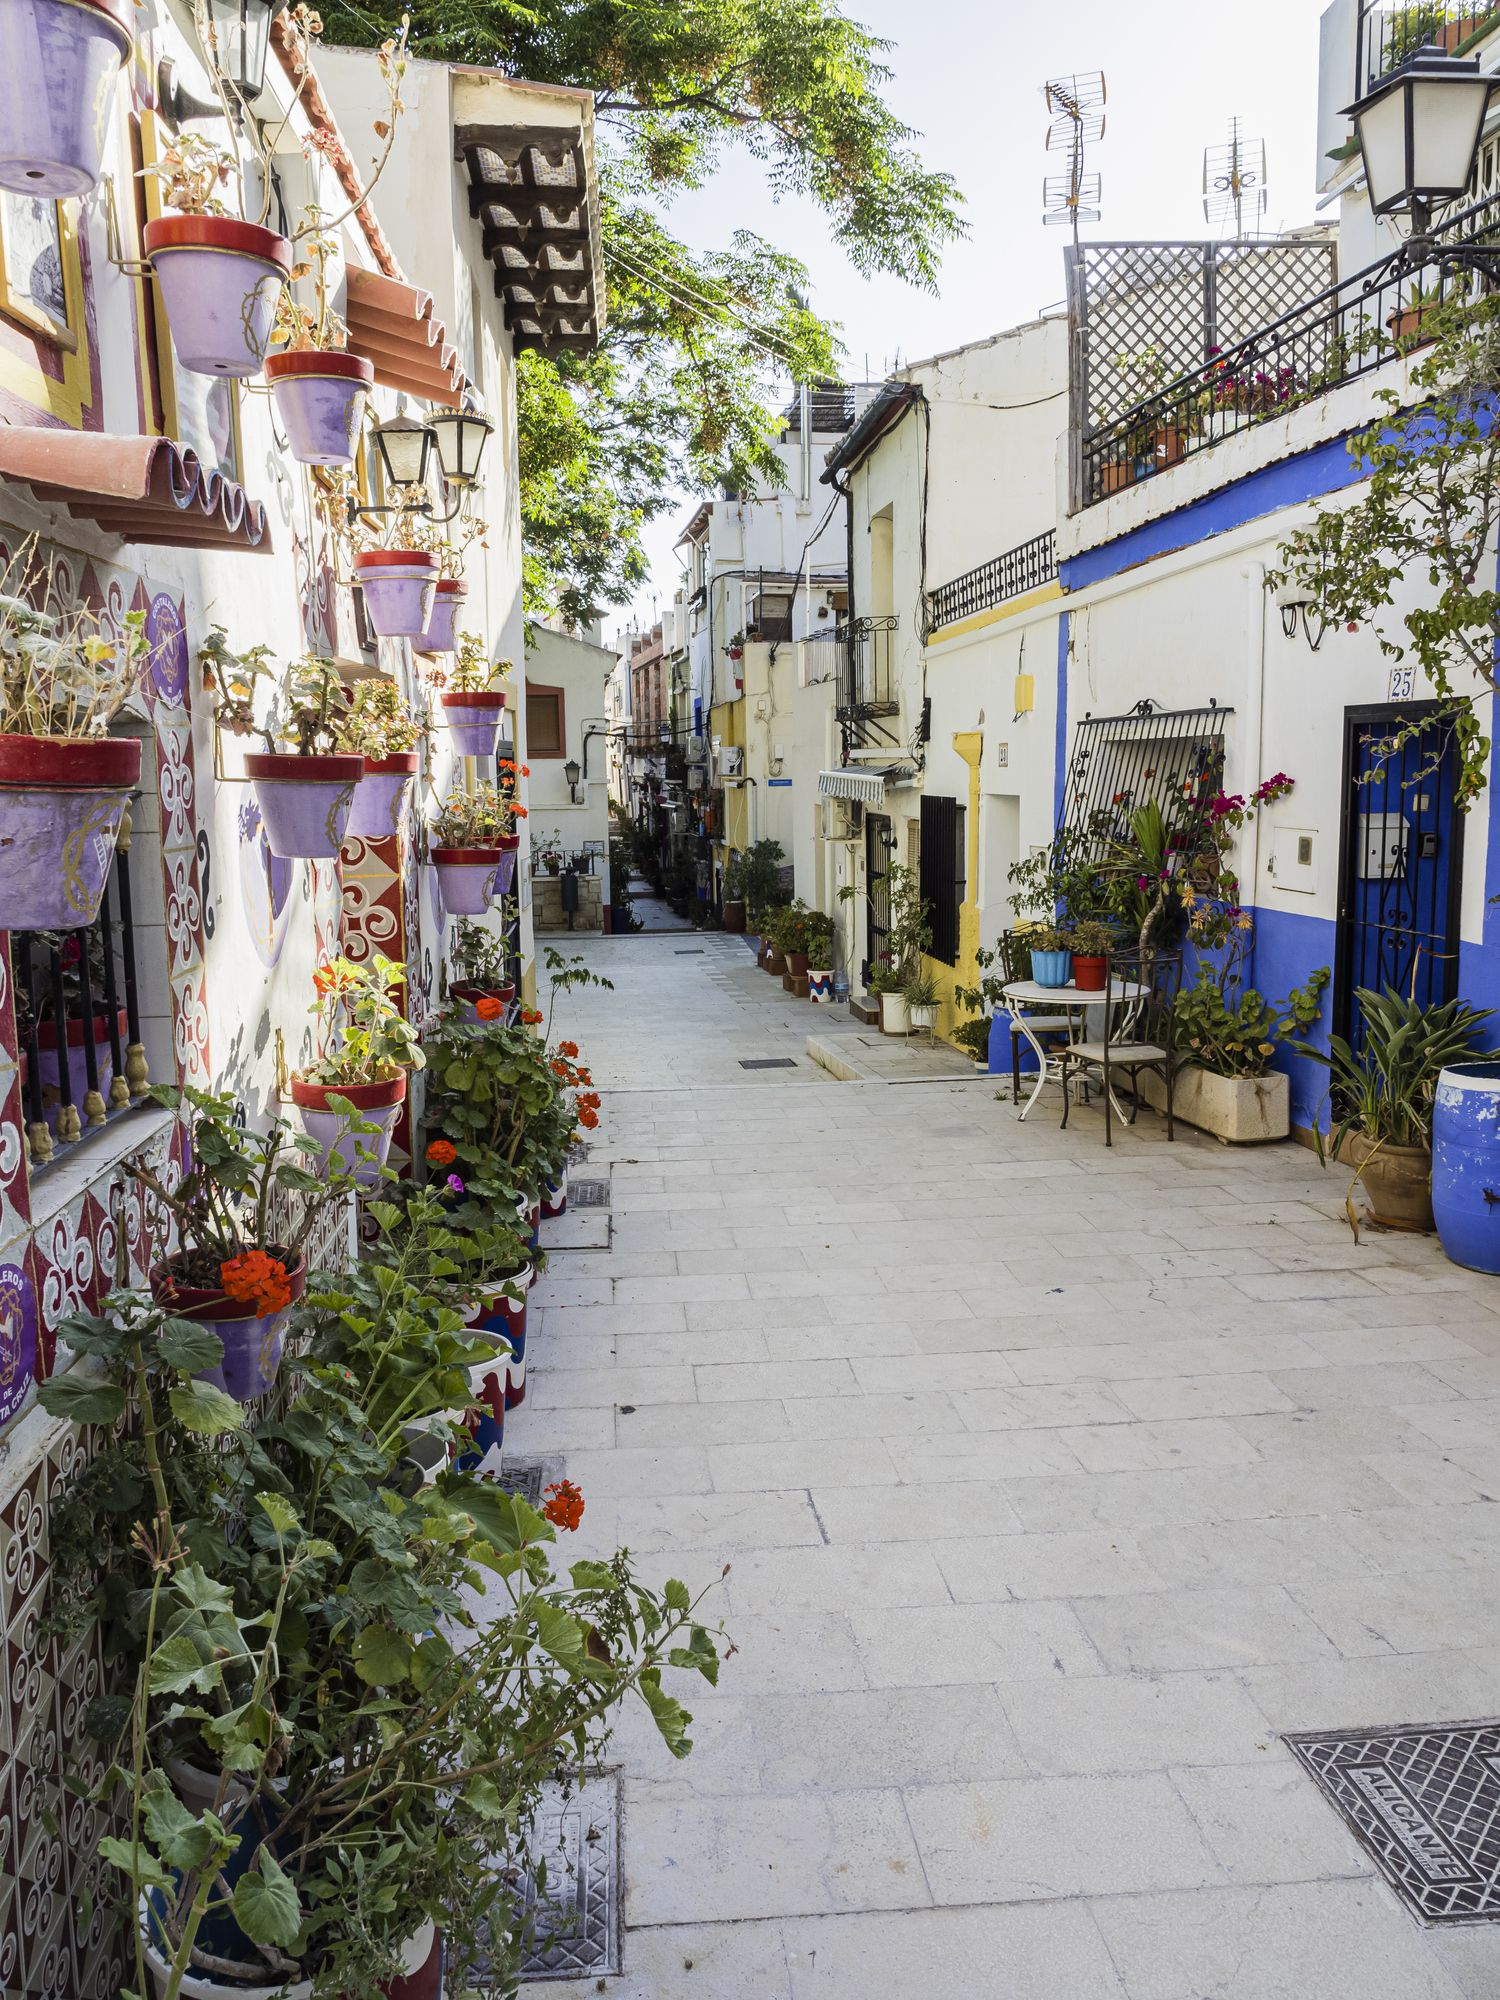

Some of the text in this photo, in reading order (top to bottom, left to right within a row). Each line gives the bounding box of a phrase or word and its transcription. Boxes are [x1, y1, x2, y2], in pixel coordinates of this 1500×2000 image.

[1391, 671, 1412, 698] 25
[3, 1386, 13, 1400] DE
[11, 1371, 31, 1410] CRUZ
[1361, 1770, 1467, 1877] ALICANTE
